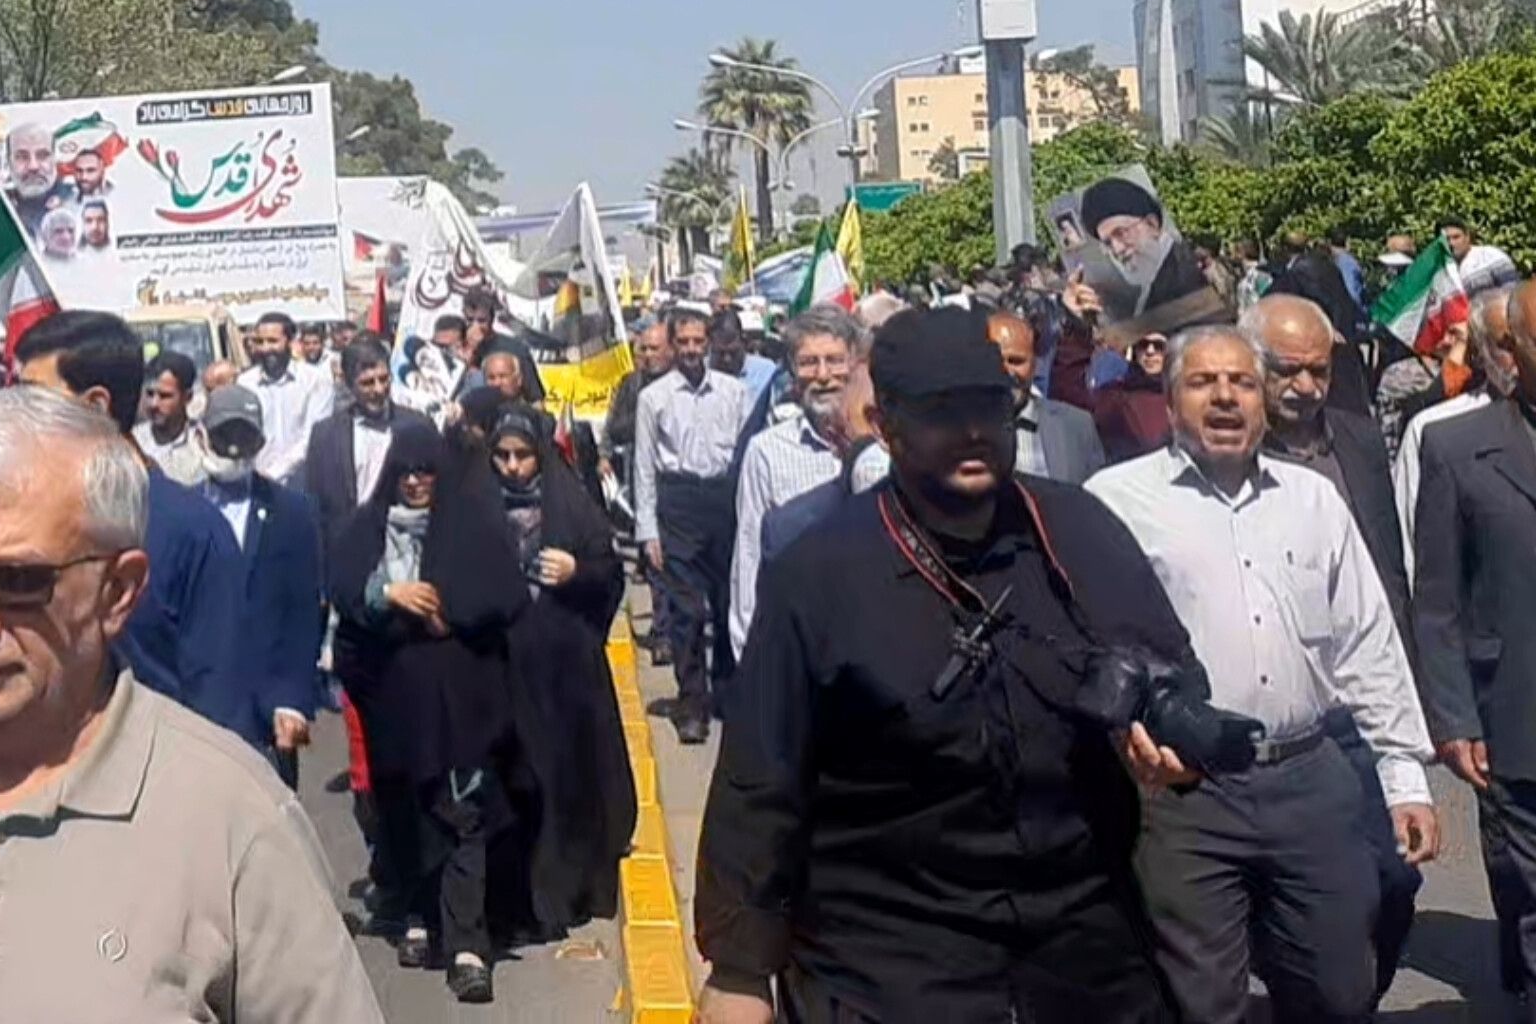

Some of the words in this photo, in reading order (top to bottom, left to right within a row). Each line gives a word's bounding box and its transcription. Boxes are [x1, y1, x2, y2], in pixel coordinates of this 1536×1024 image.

[140, 103, 156, 122] باد
[207, 97, 243, 117] قدس
[244, 95, 288, 115] جهانی
[287, 94, 307, 114] روز
